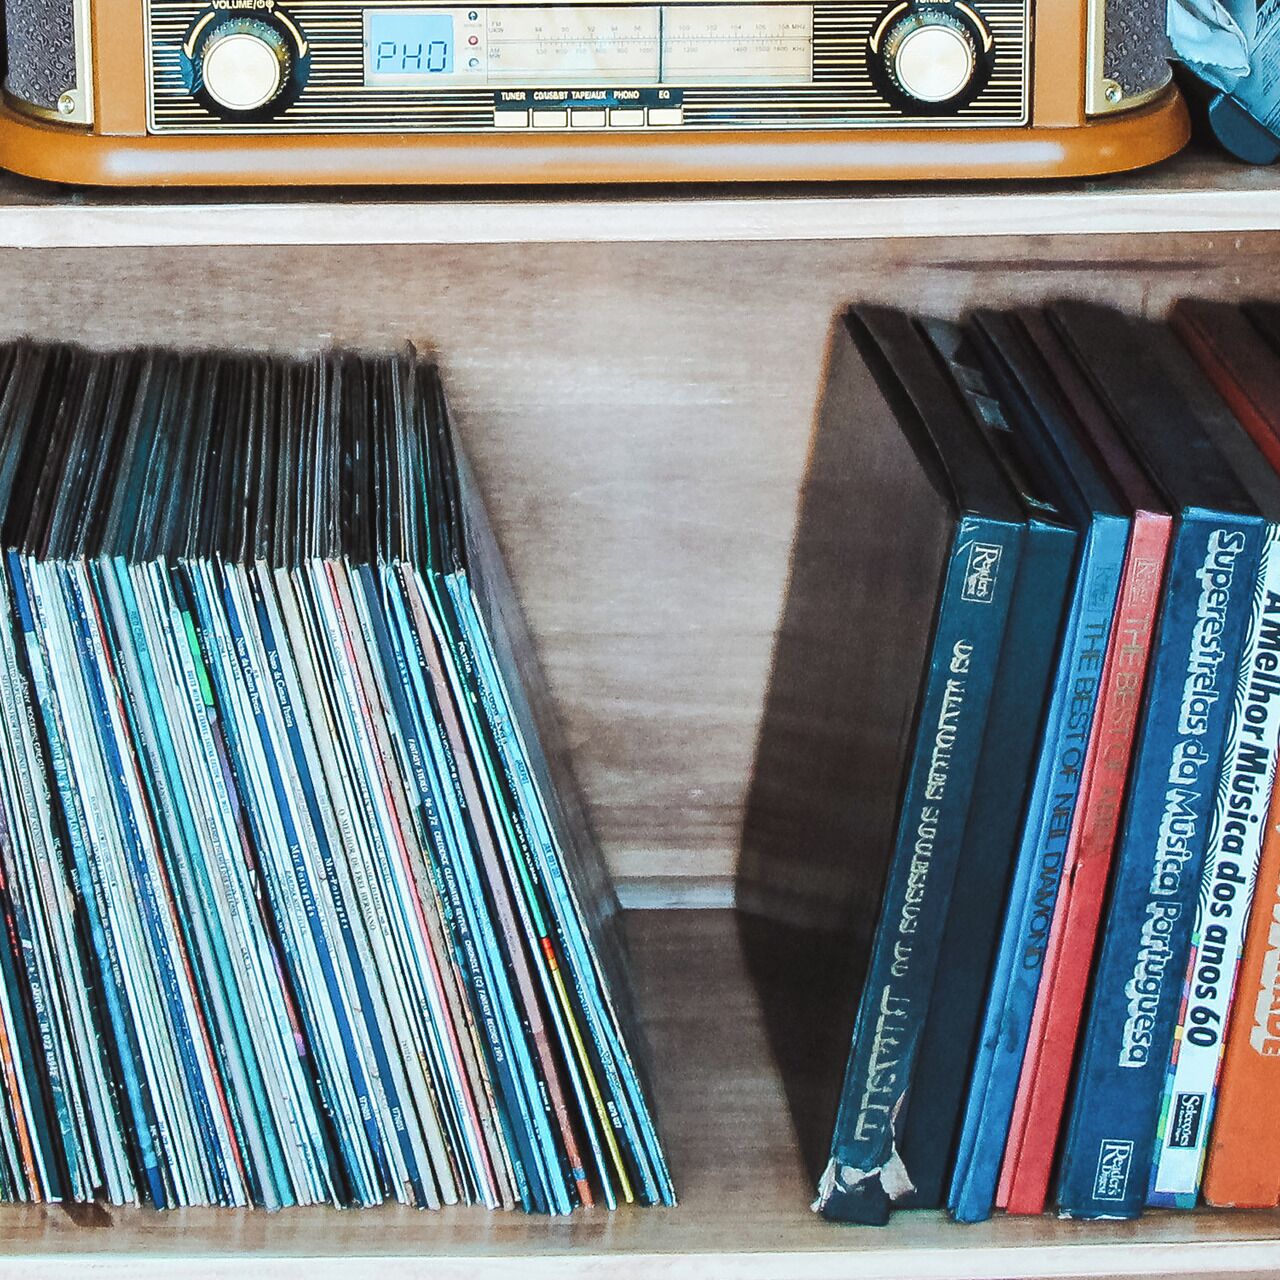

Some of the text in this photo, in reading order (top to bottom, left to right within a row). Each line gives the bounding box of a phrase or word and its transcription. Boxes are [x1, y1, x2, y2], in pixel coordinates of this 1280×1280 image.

[501, 91, 526, 101] TUNER
[613, 90, 640, 99] PHONO
[658, 90, 670, 99] EQ
[973, 546, 998, 597] Reader's
[234, 636, 247, 656] Nuno
[240, 658, 250, 666] da
[267, 649, 280, 669] Nuno
[1078, 620, 1106, 671] THE
[1119, 616, 1150, 671] THE
[1065, 675, 1096, 739] BEST
[1059, 746, 1082, 783] OF
[1049, 793, 1072, 841] NEIL
[1119, 529, 1246, 1068] Superestrelas da Música Portuguesa
[339, 818, 356, 854] MELHOR
[353, 870, 366, 889] FREI
[406, 738, 421, 766] FANTASY
[415, 768, 429, 792] STEREO
[432, 830, 449, 865] CREEDENCE
[462, 939, 480, 973] CHRONICLE
[477, 989, 492, 1015] FANTASY
[1209, 860, 1246, 918] dos
[359, 891, 377, 930] HERMANO
[1023, 851, 1063, 971] DIAMOND
[1195, 924, 1228, 1000] anos
[1186, 1006, 1221, 1047] 60
[1094, 1140, 1132, 1197] Reader's
